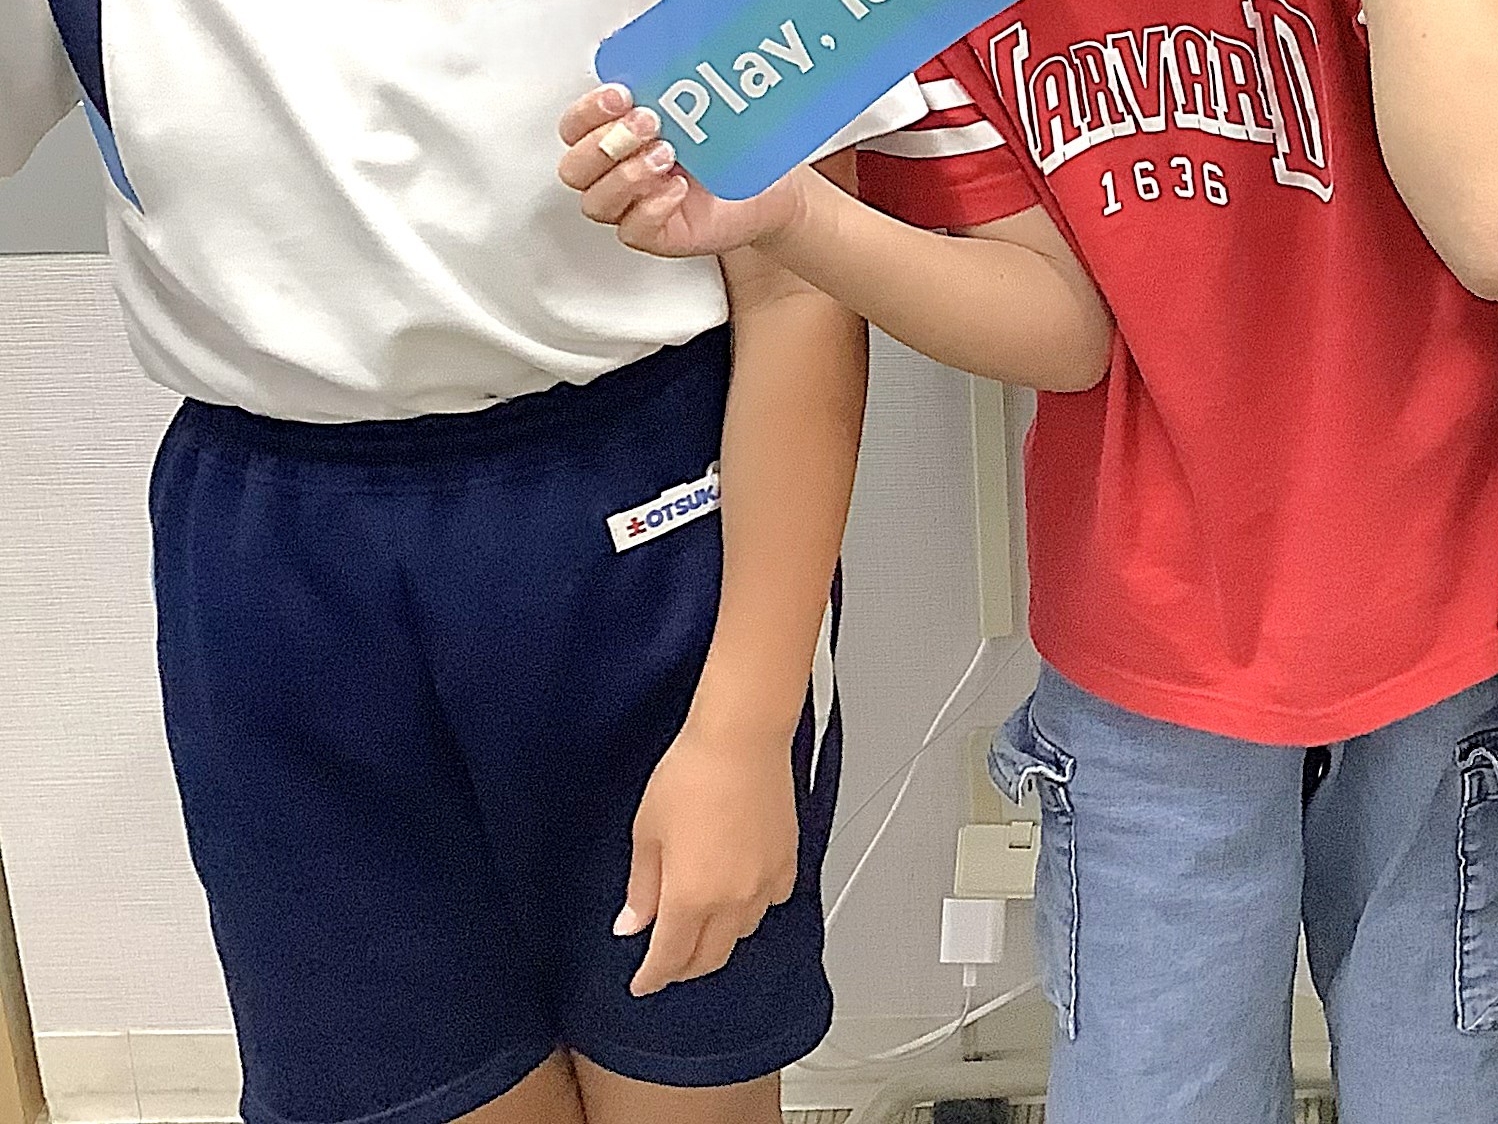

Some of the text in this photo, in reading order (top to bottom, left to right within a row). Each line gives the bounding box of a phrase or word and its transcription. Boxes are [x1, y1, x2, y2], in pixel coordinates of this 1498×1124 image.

[658, 19, 838, 145] Play,
[1100, 156, 1230, 217] 1636
[645, 484, 720, 528] OTSUK
